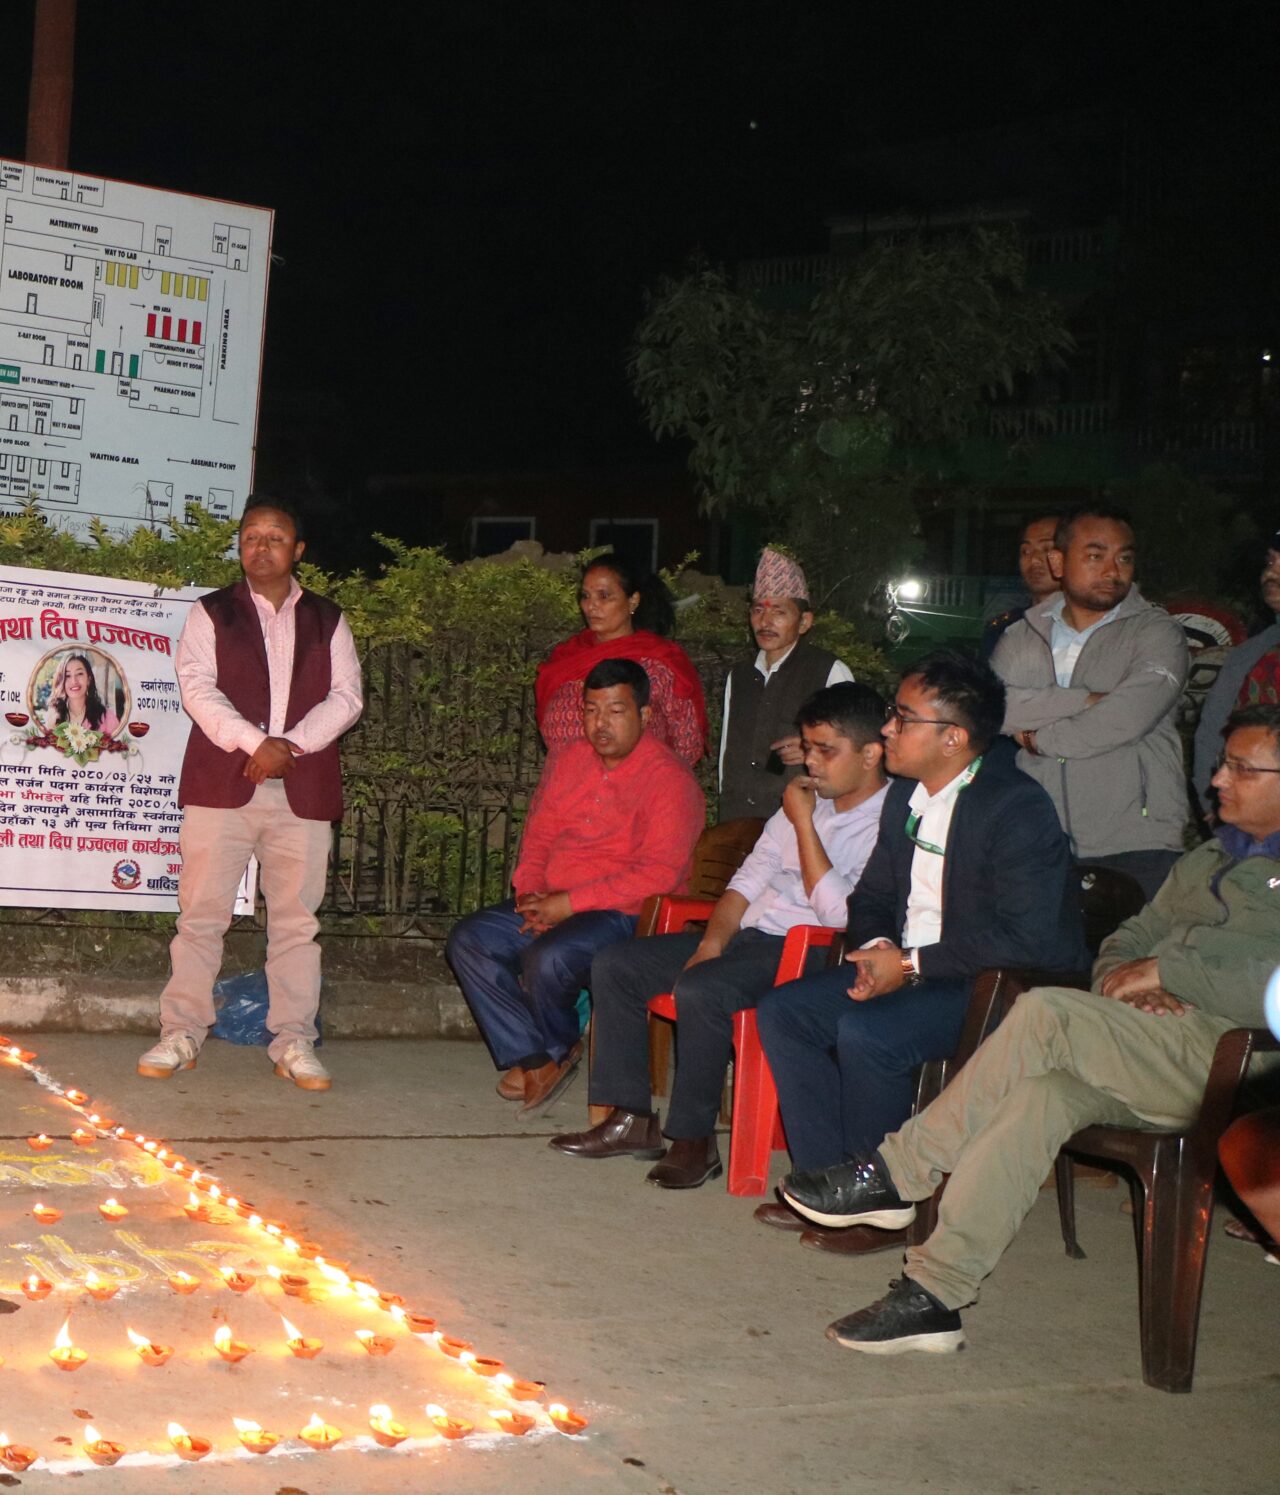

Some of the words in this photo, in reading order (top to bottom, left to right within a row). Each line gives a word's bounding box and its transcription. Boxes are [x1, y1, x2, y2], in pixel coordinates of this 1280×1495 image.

[49, 219, 81, 231] MATERNITY
[81, 224, 99, 234] WARD
[104, 248, 117, 256] WAY
[118, 250, 126, 258] TO
[126, 252, 137, 260] LAB
[8, 269, 57, 285] LABORATORY
[60, 278, 84, 290] ROOM
[18, 331, 31, 340] X-RAY
[220, 332, 228, 370] PARKING
[7, 369, 18, 378] AREA
[154, 386, 180, 396] PHARMACY
[90, 452, 120, 462] WAITING
[121, 456, 140, 465] AREA
[190, 458, 218, 468] ASSEMBLY
[219, 462, 236, 471] POINT
[13, 484, 26, 492] ROOM
[47, 592, 70, 600] समान
[68, 602, 86, 611] मिति
[40, 609, 79, 642] दिप
[86, 620, 172, 657] प्रज्वलन
[38, 764, 66, 777] मिति
[71, 769, 152, 784] २०८०/०३/२५
[159, 775, 176, 784] गते
[15, 776, 44, 788] सर्जन
[50, 781, 80, 791] पदमा
[84, 782, 125, 794] कार्यरत
[131, 784, 172, 797] विशेषज्ञ
[21, 788, 64, 802] धौभडेल
[70, 793, 90, 806] यहि
[96, 795, 123, 806] मिति
[23, 803, 70, 818] अल्पायुमै
[42, 819, 57, 828] १३
[113, 820, 152, 832] तिथिमा
[18, 833, 44, 849] तथा
[49, 831, 73, 850] दिप
[76, 836, 128, 854] प्रज्वलन
